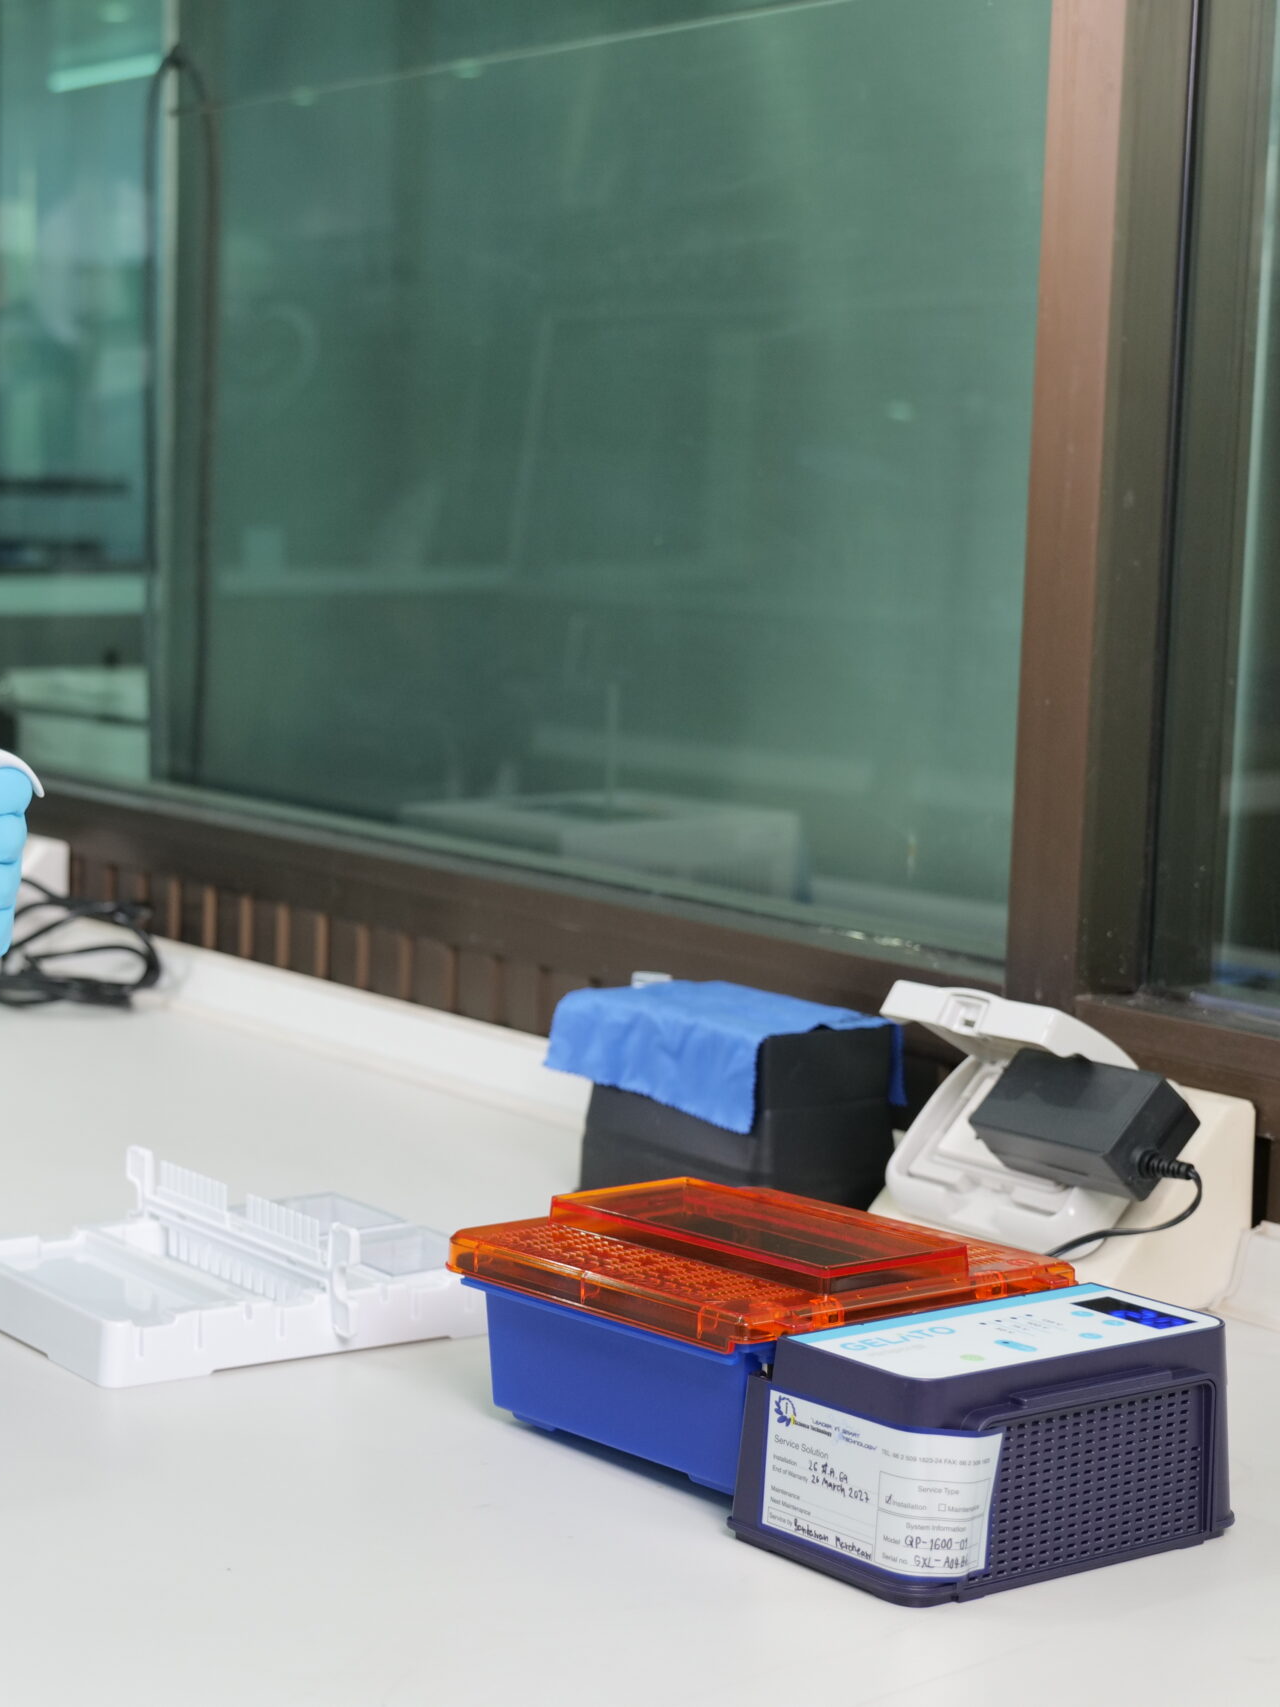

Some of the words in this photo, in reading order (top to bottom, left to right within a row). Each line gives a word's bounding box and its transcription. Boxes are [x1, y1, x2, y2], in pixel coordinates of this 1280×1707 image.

[839, 1326, 956, 1351] GELATO
[774, 1433, 800, 1450] Service
[800, 1443, 829, 1460] Solution
[771, 1464, 782, 1473] End
[808, 1460, 818, 1472] 26
[770, 1485, 801, 1501] Maintenance
[848, 1487, 870, 1504] 2027
[917, 1485, 943, 1494] Service
[943, 1487, 960, 1497] Type
[892, 1500, 927, 1511] Installation
[905, 1522, 931, 1532] System
[882, 1534, 901, 1545] Model
